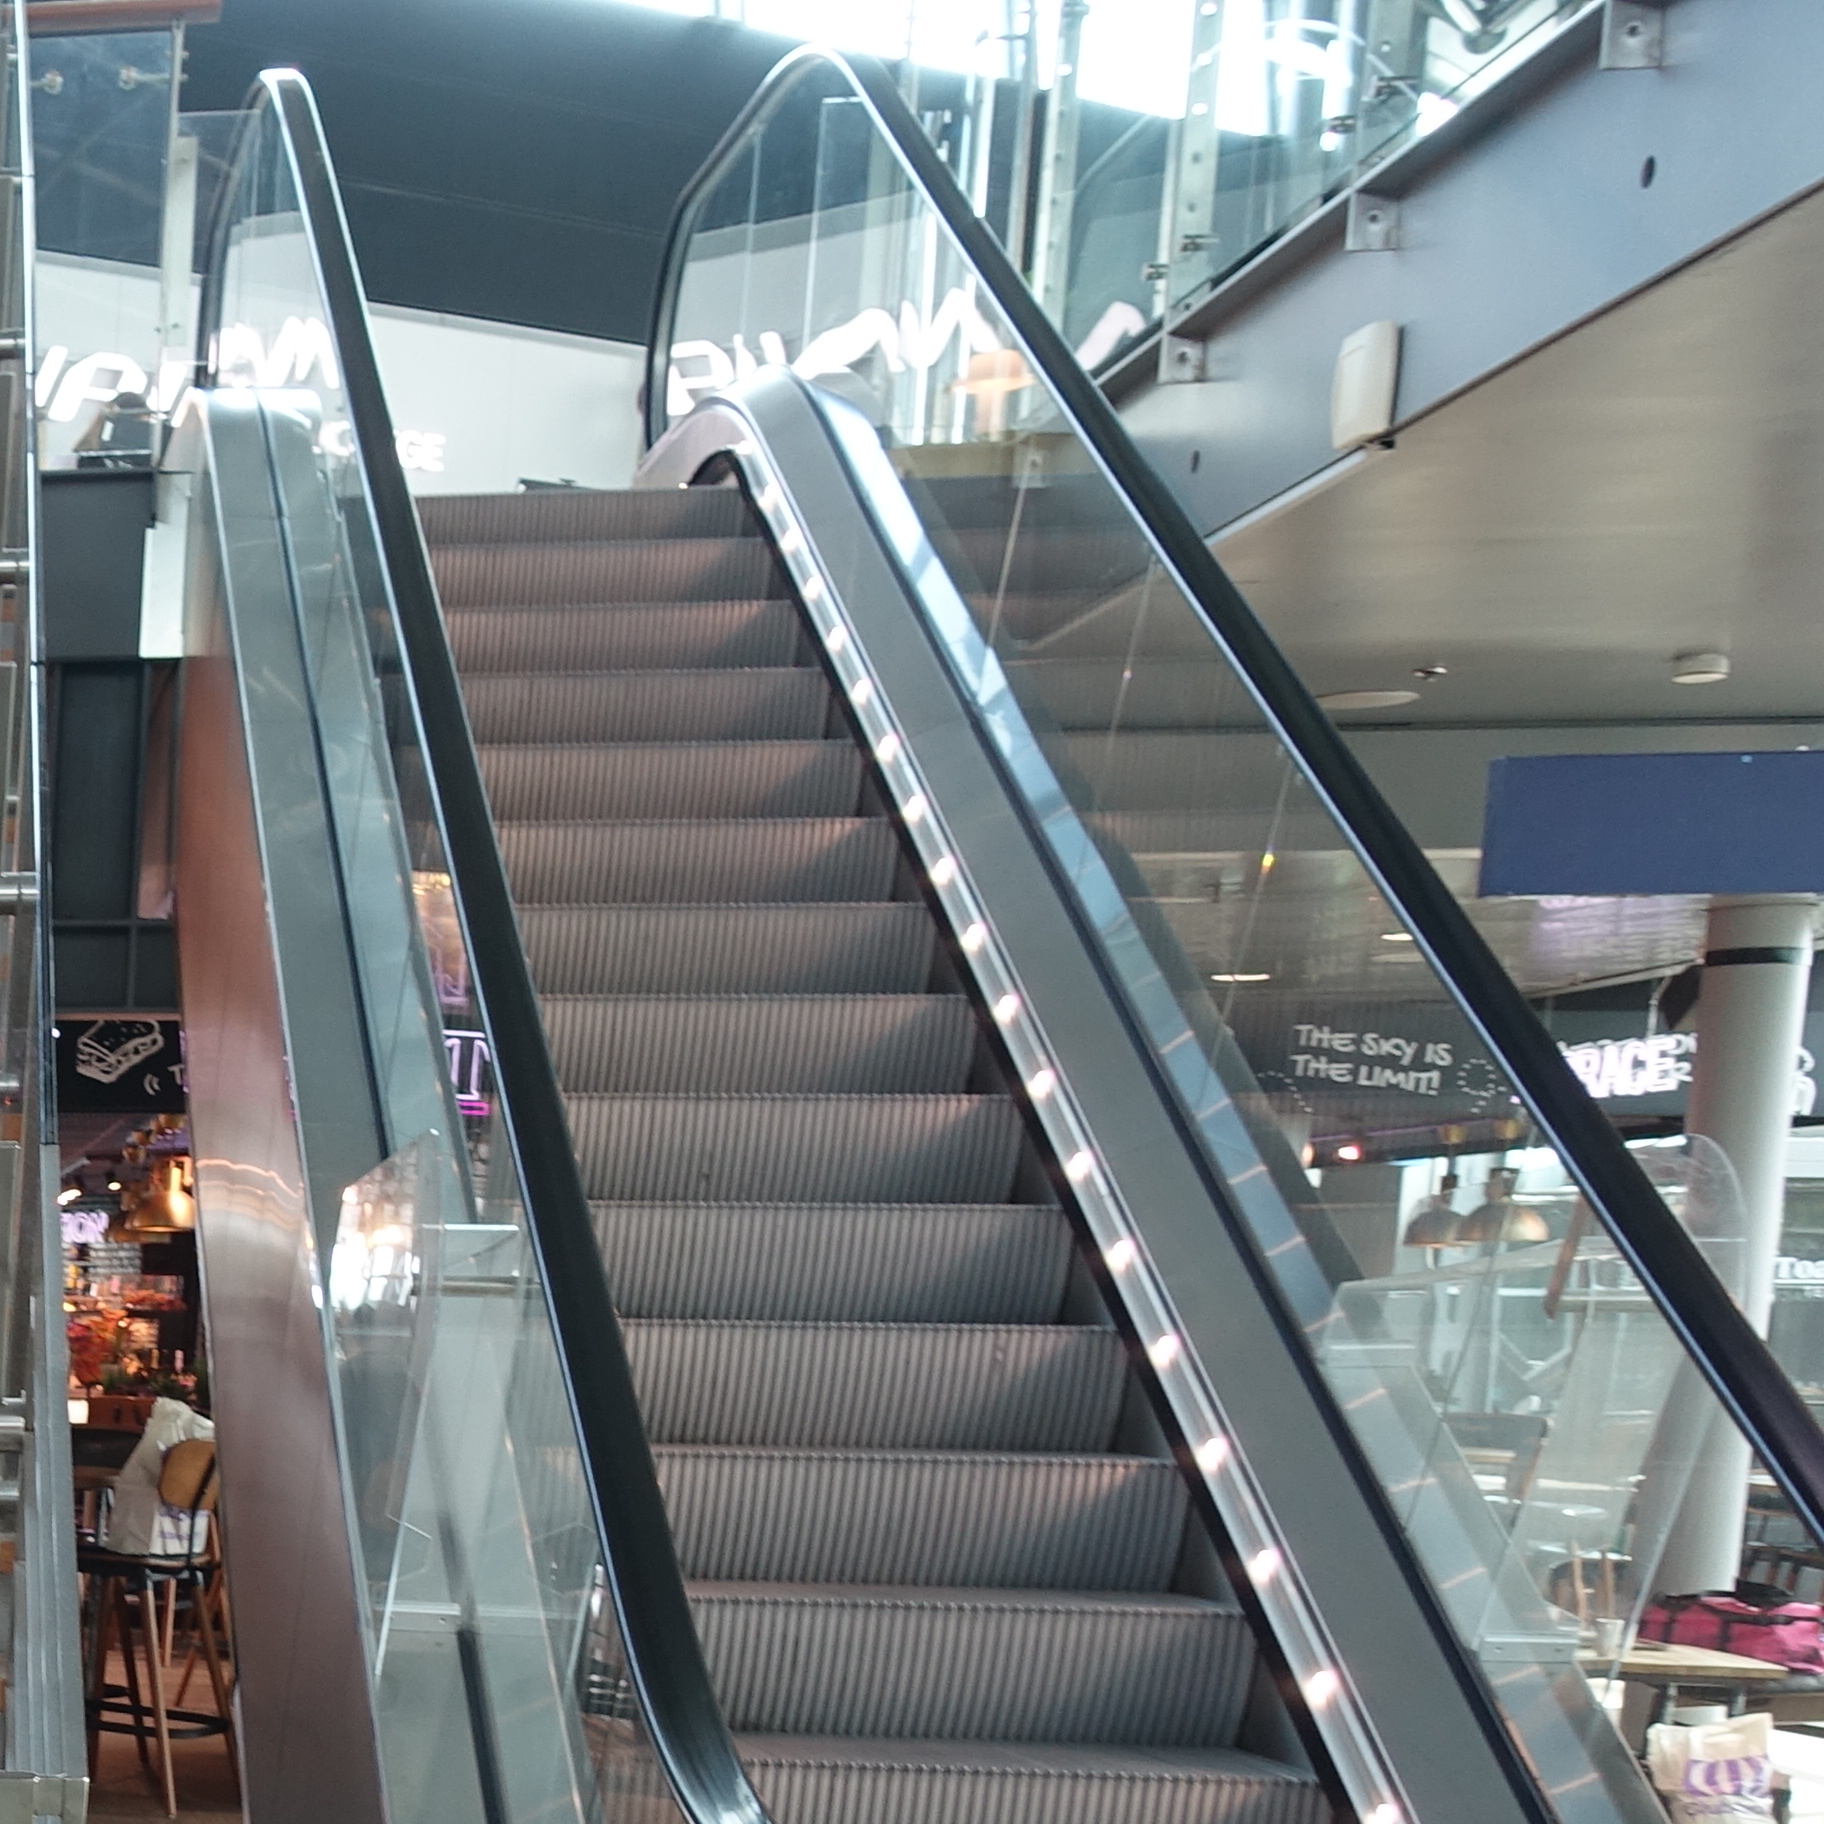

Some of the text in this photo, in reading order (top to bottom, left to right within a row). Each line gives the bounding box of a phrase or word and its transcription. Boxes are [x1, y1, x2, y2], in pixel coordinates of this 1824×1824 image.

[1293, 1024, 1453, 1066] THE SKY IS
[1290, 1054, 1354, 1083] THE
